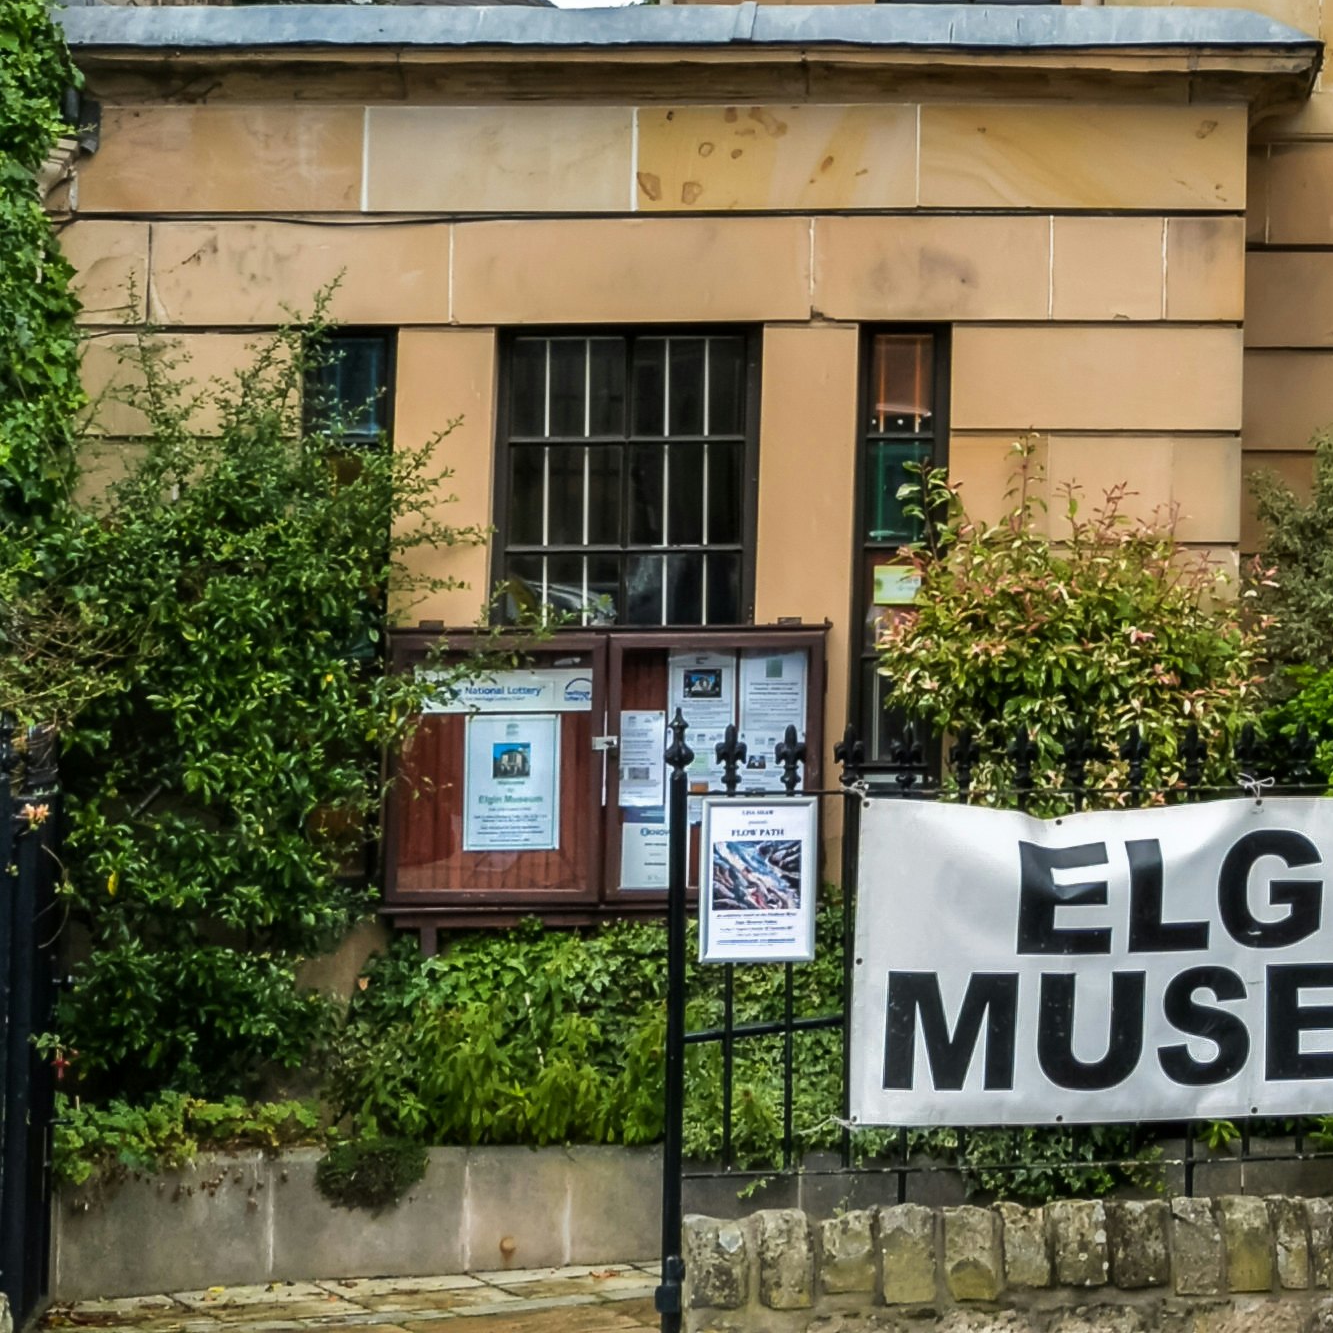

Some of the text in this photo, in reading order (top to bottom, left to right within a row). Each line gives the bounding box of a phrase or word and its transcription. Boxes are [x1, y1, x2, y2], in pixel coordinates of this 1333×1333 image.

[465, 685, 542, 697] National Lottery
[759, 828, 785, 837] PATH
